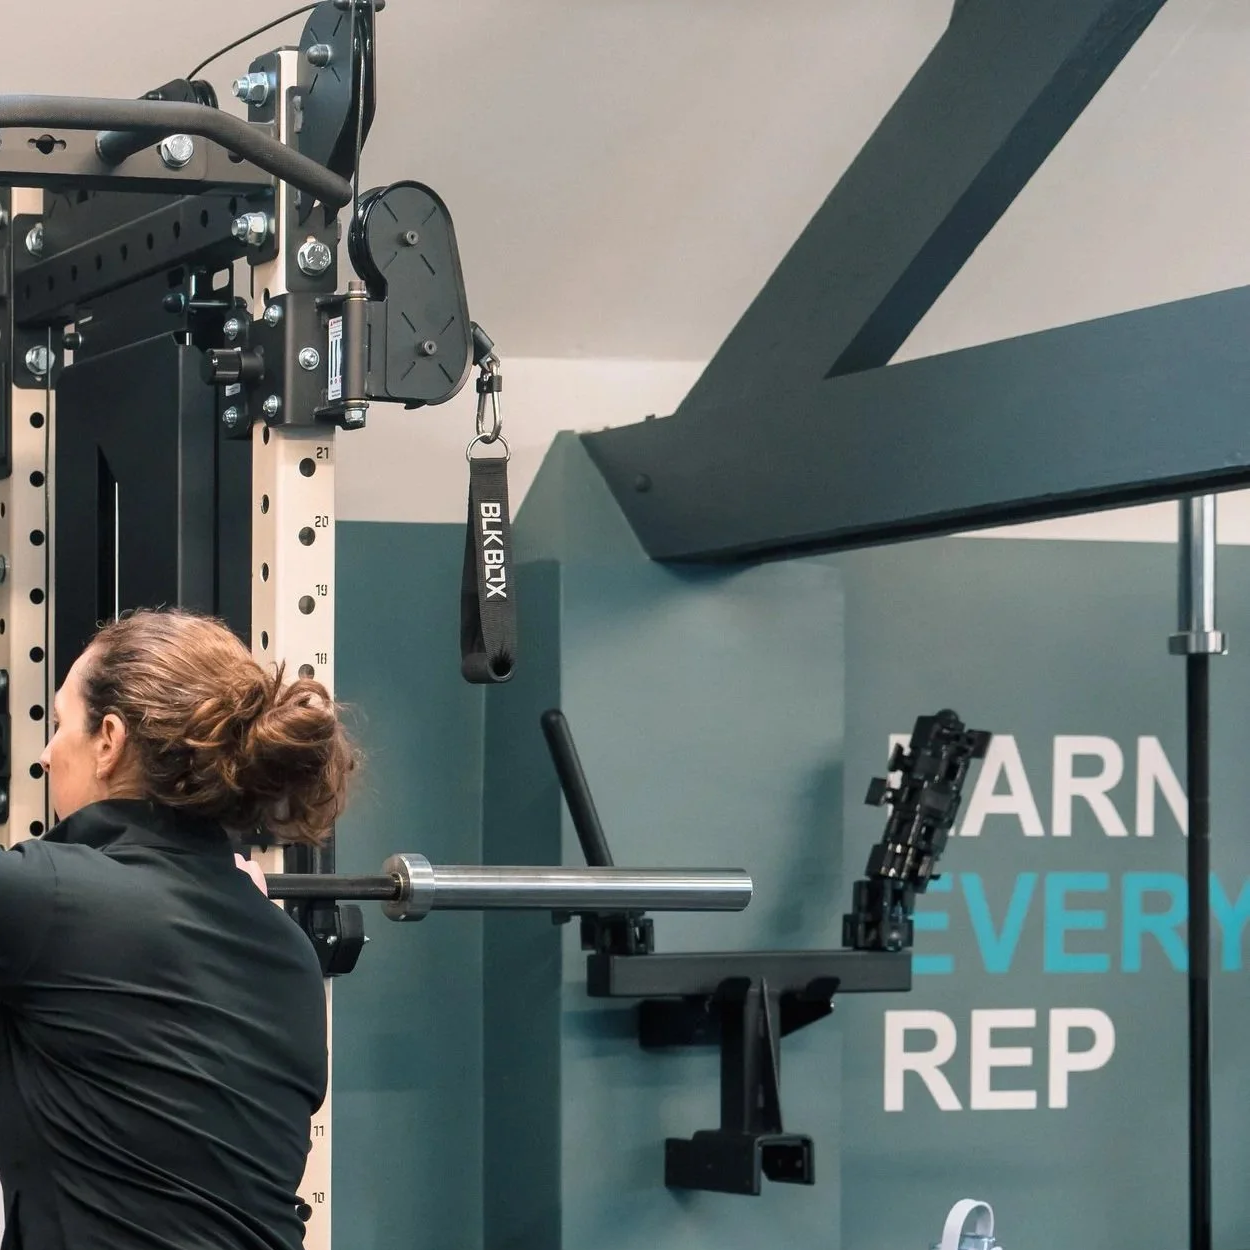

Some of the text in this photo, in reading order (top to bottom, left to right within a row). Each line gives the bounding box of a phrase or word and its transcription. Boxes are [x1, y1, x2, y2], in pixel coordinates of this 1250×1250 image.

[480, 503, 507, 598] BLK BOX
[884, 1008, 1116, 1111] REP
